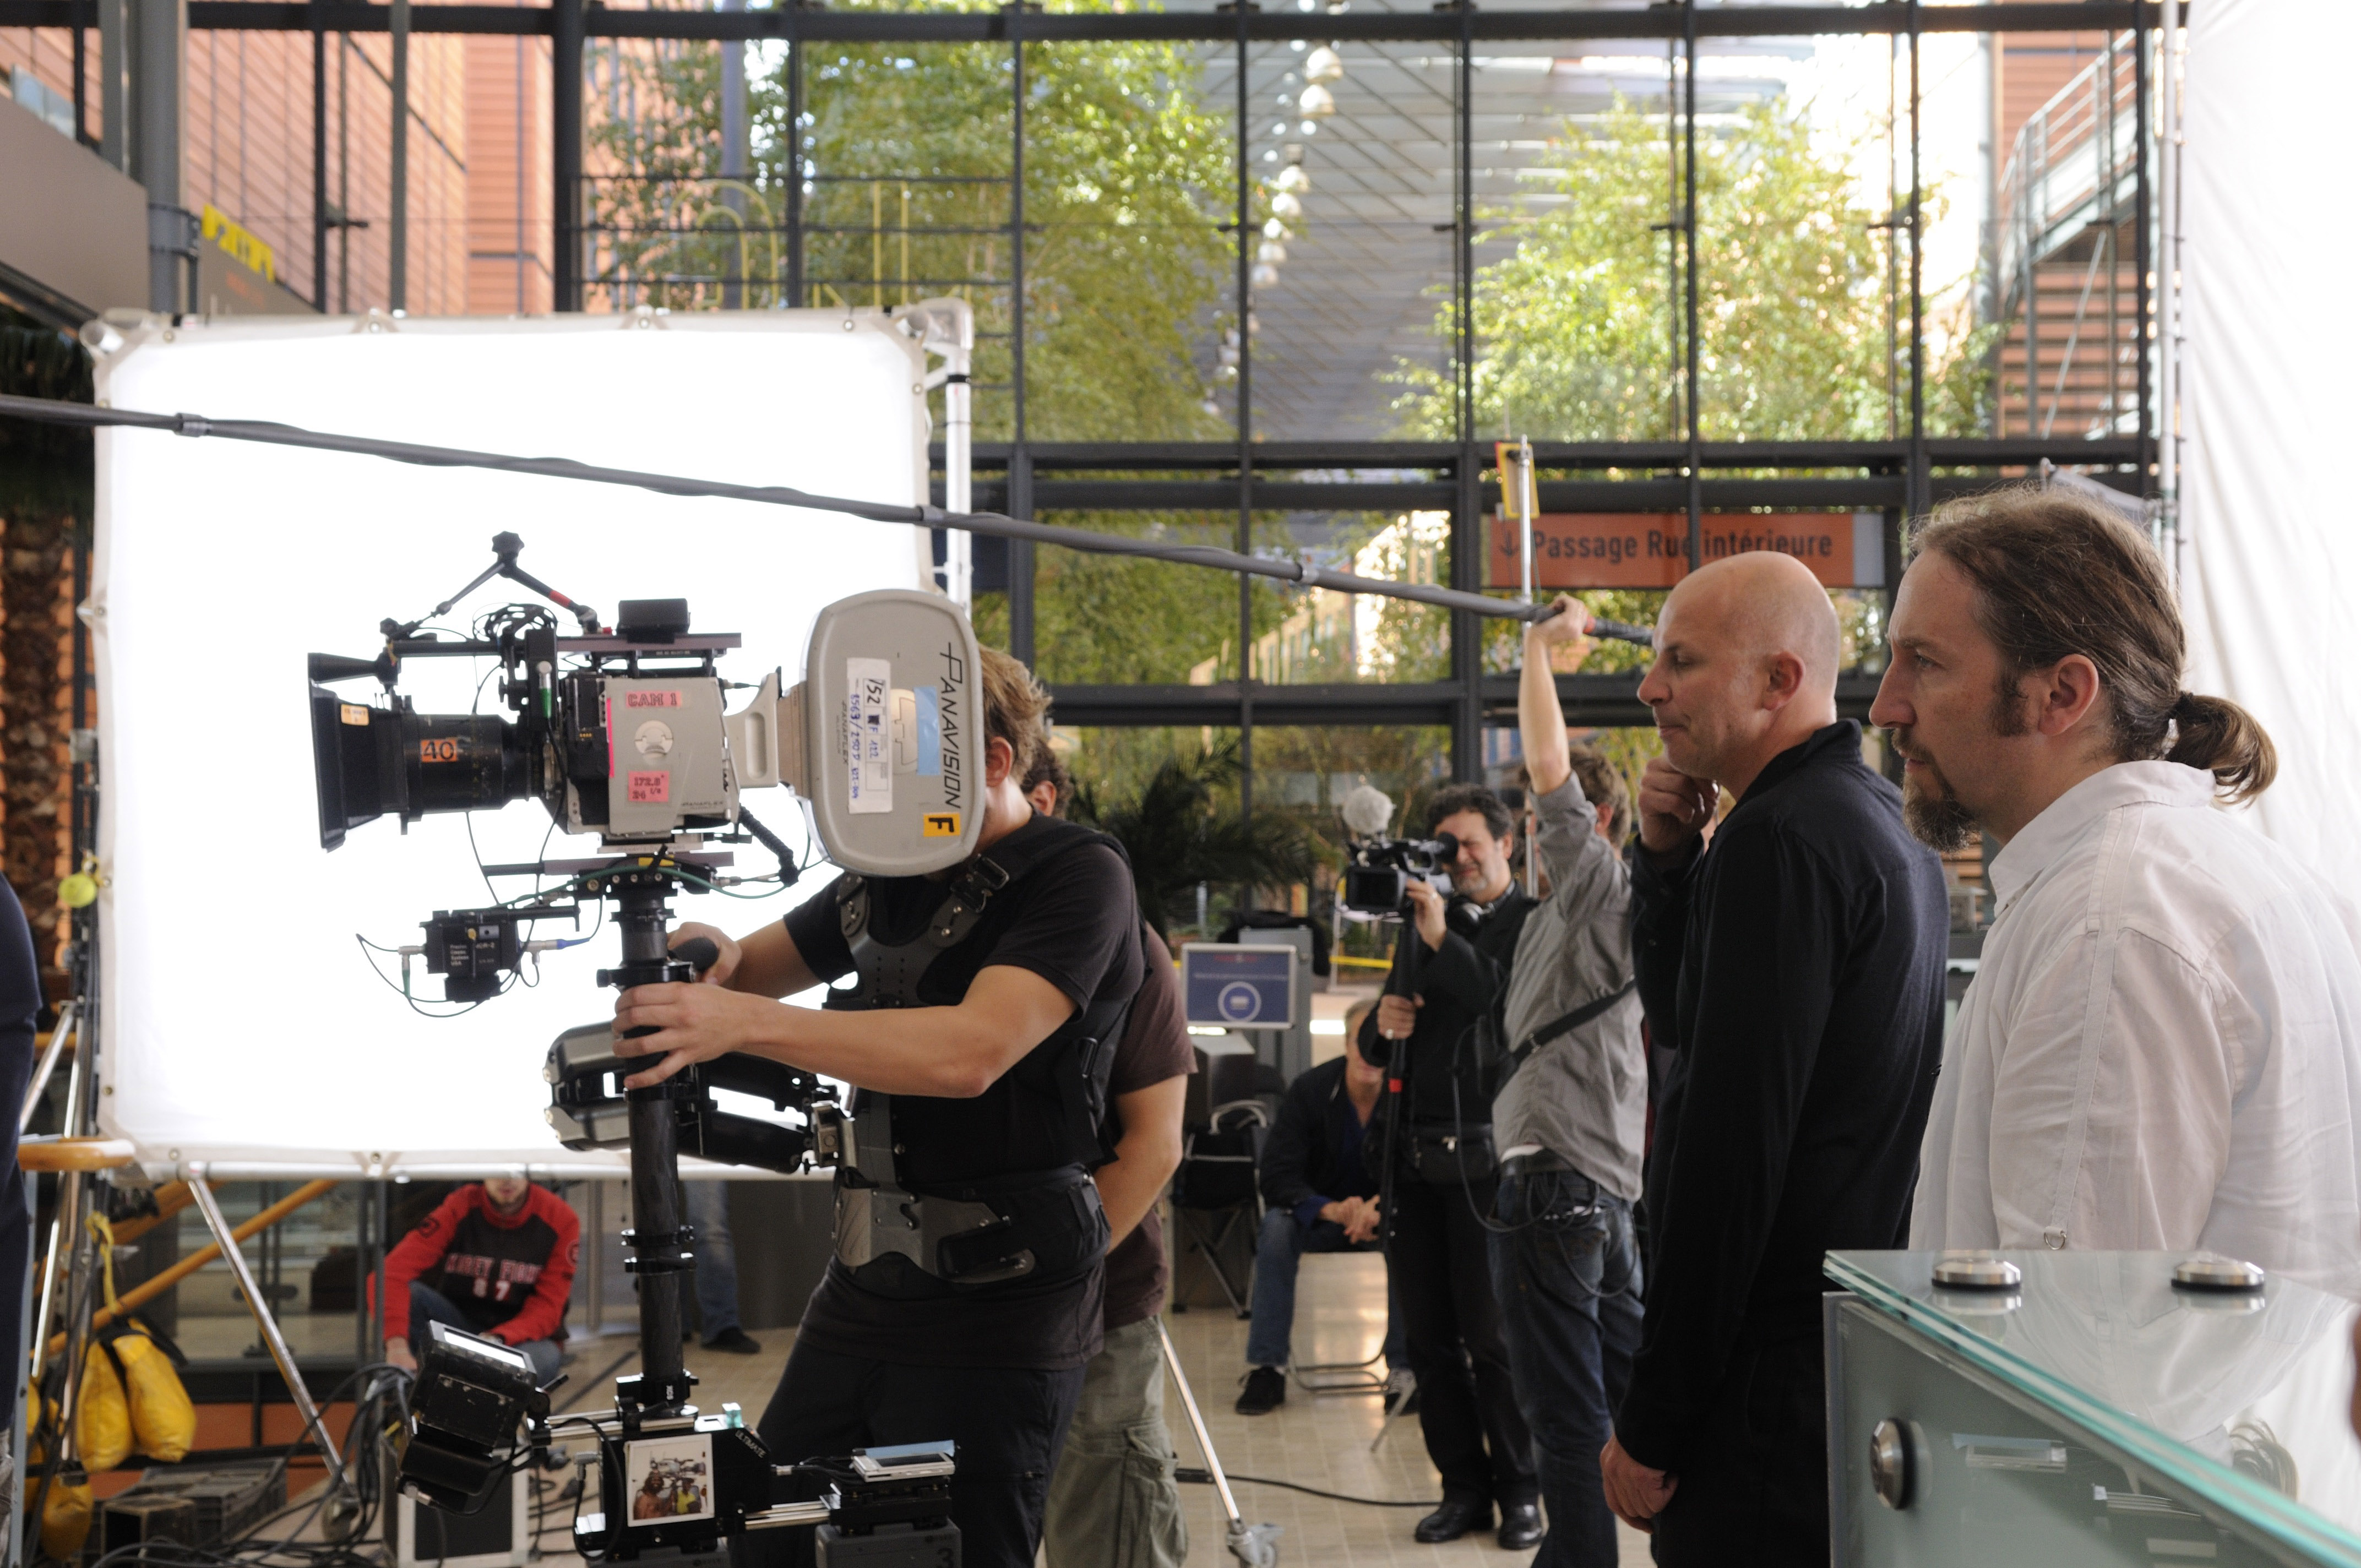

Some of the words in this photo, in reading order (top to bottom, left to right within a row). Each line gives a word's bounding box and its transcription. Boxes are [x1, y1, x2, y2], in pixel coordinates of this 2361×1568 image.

[1532, 530, 1638, 564] Passage
[1705, 529, 1832, 557] intérieure
[628, 693, 663, 707] CAM
[671, 694, 677, 705] 1
[939, 642, 962, 809] PANAVISION
[423, 741, 455, 760] 40
[928, 817, 955, 832] F
[735, 1429, 767, 1458] ULTIMATE
